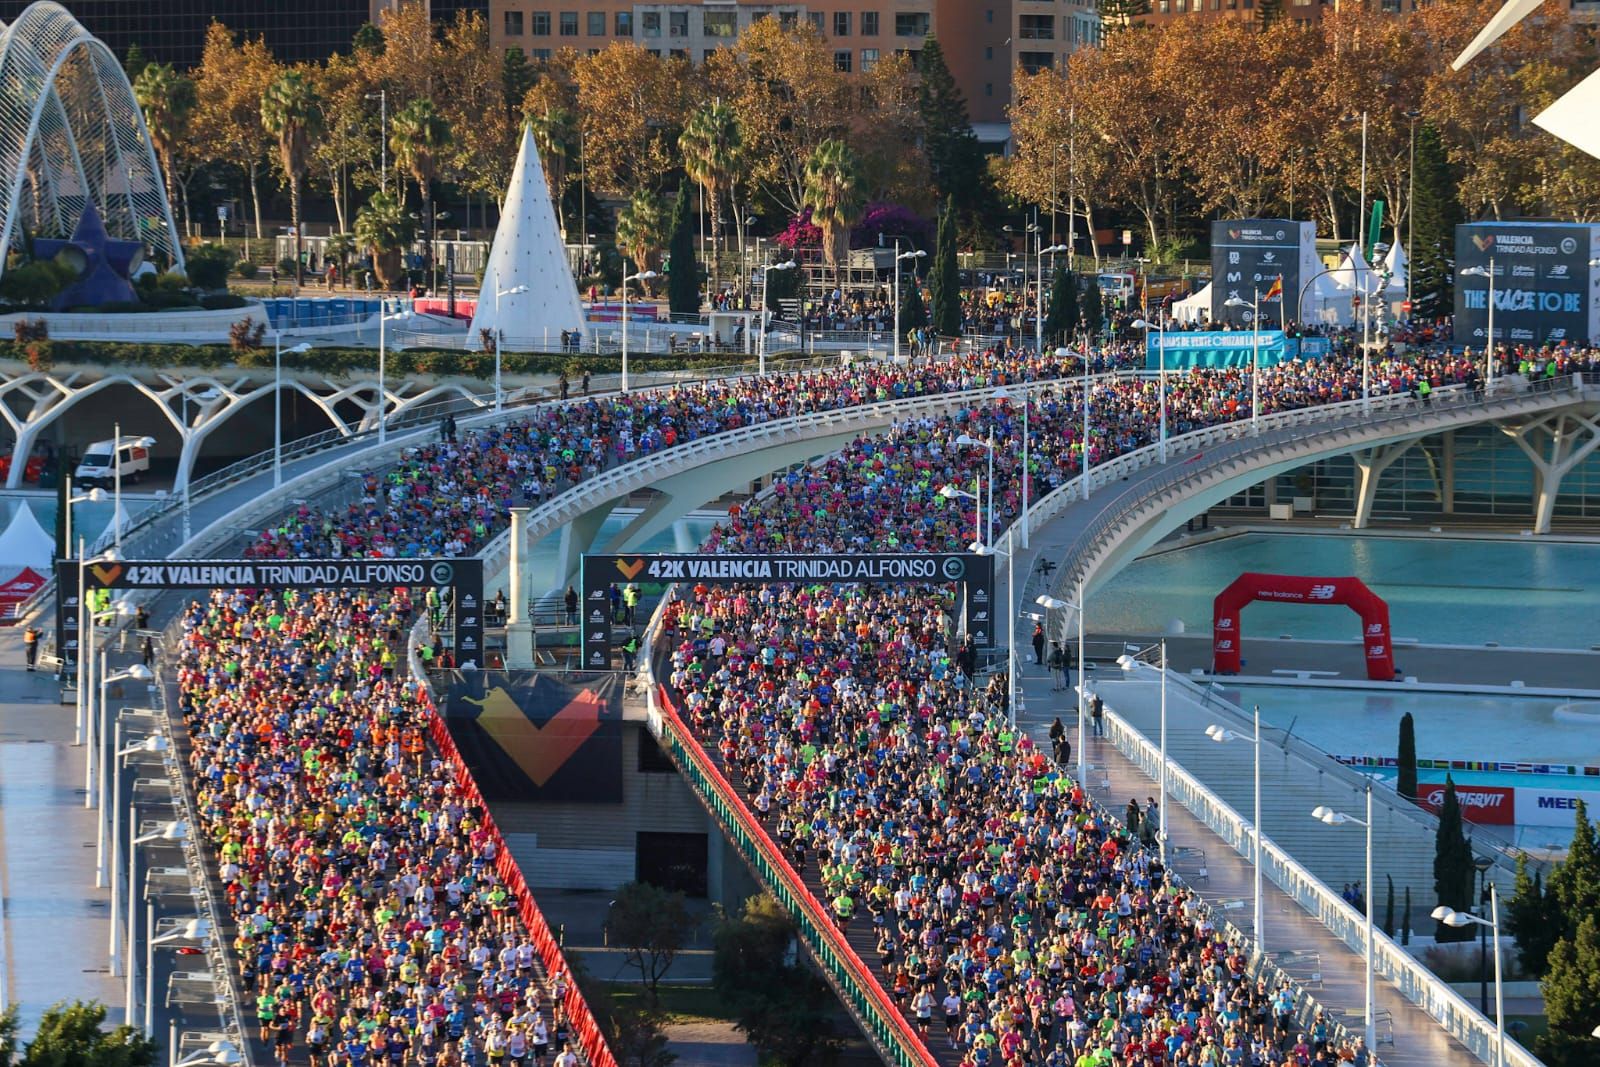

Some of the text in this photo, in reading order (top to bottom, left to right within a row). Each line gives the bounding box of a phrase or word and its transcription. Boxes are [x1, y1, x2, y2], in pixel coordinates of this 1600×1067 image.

[1496, 235, 1534, 245] VALENCIA
[1496, 245, 1558, 255] TRINIDAD ALFONSO
[1464, 290, 1486, 309] THE
[1538, 292, 1562, 312] TO
[1564, 293, 1580, 312] BE
[125, 564, 424, 584] 42K VALENCIA TRINIDAD ALFONSO
[648, 559, 936, 578] 42K VALENCIA TRINIDAD ALFONSO
